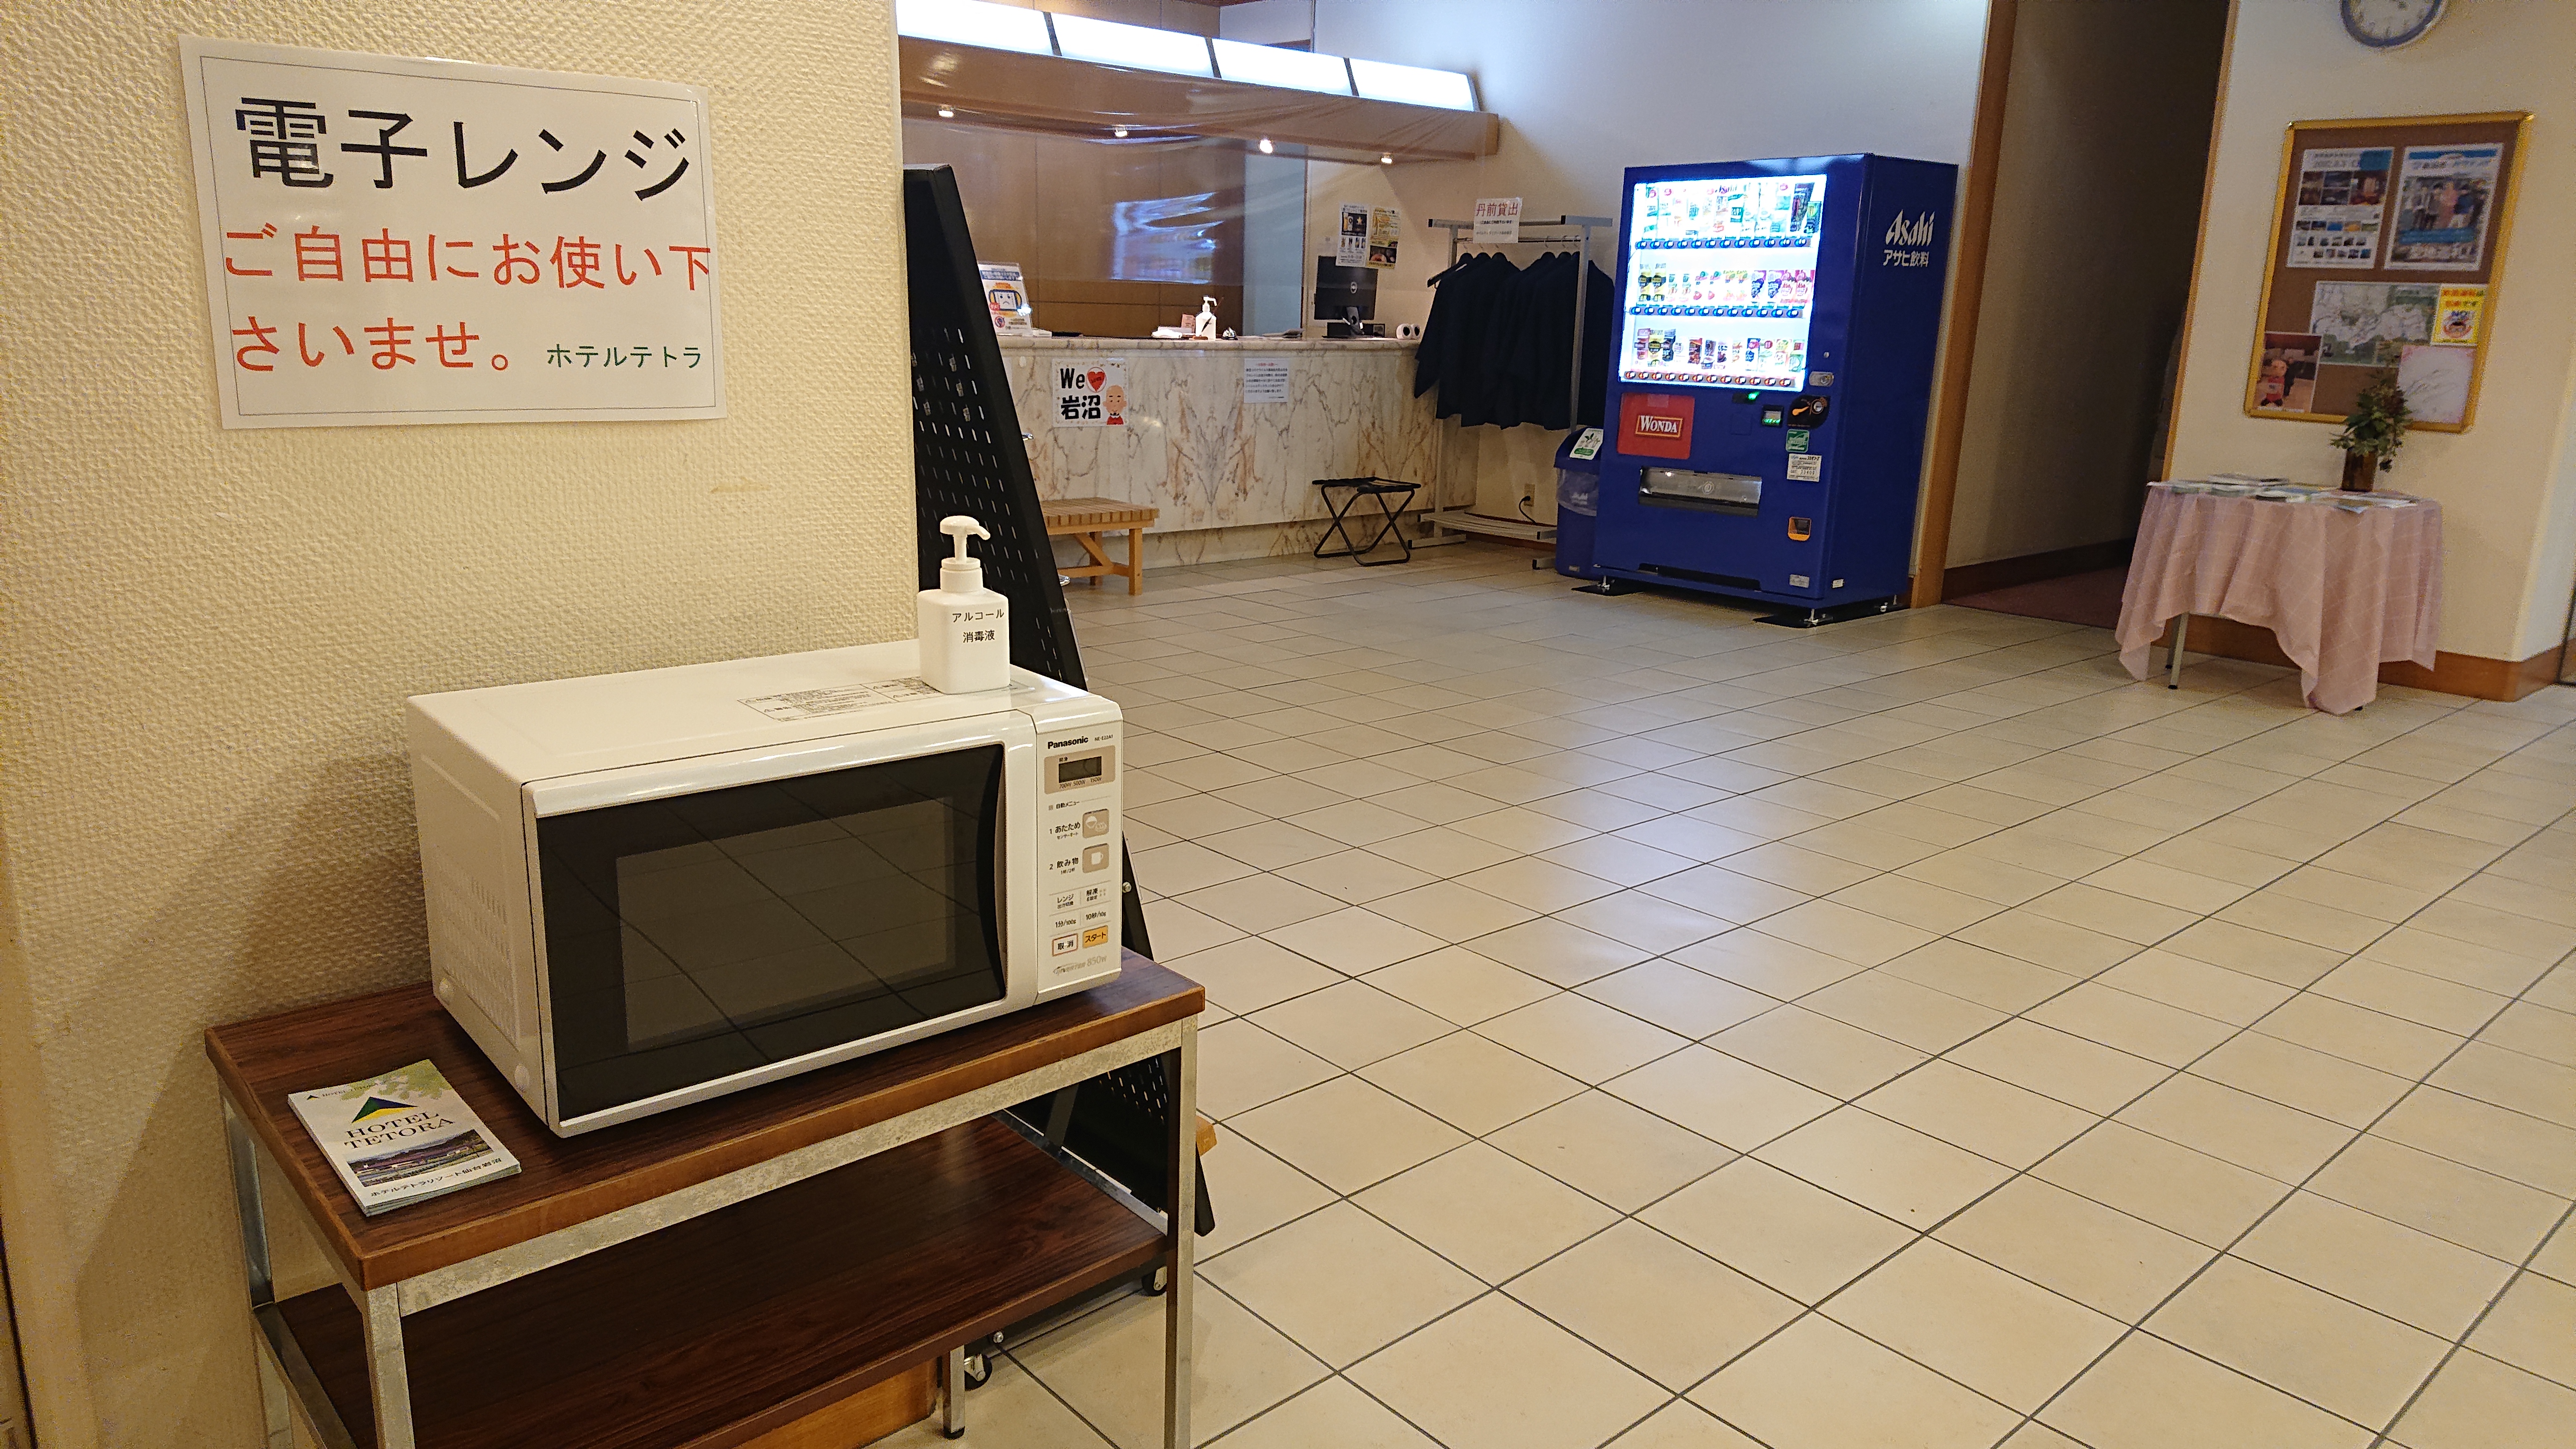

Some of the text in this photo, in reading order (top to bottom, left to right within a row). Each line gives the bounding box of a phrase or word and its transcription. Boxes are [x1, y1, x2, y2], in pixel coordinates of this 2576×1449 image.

[235, 97, 690, 201] 電子レンジ
[1476, 202, 1518, 217] 丹前貸出
[1885, 209, 1935, 246] Asahi
[225, 222, 711, 291] ご自由にお使い下
[1883, 249, 1929, 267] アサヒ飲料
[232, 316, 509, 372] さいませ。
[546, 343, 702, 368] ホテルテトラ
[1060, 368, 1085, 389] We
[1061, 395, 1101, 419] 岩沼
[1640, 415, 1677, 433] WONDA
[952, 608, 1004, 623] アルコール
[963, 629, 995, 643] 消毒液
[1047, 736, 1089, 749] Panasonic
[1055, 821, 1081, 834] あたため
[1057, 857, 1079, 869] 飲み物
[1057, 893, 1074, 903] レンジ
[1085, 931, 1106, 943] スタート
[344, 1118, 455, 1149] TETORA
[345, 1112, 439, 1138] HOTEL
